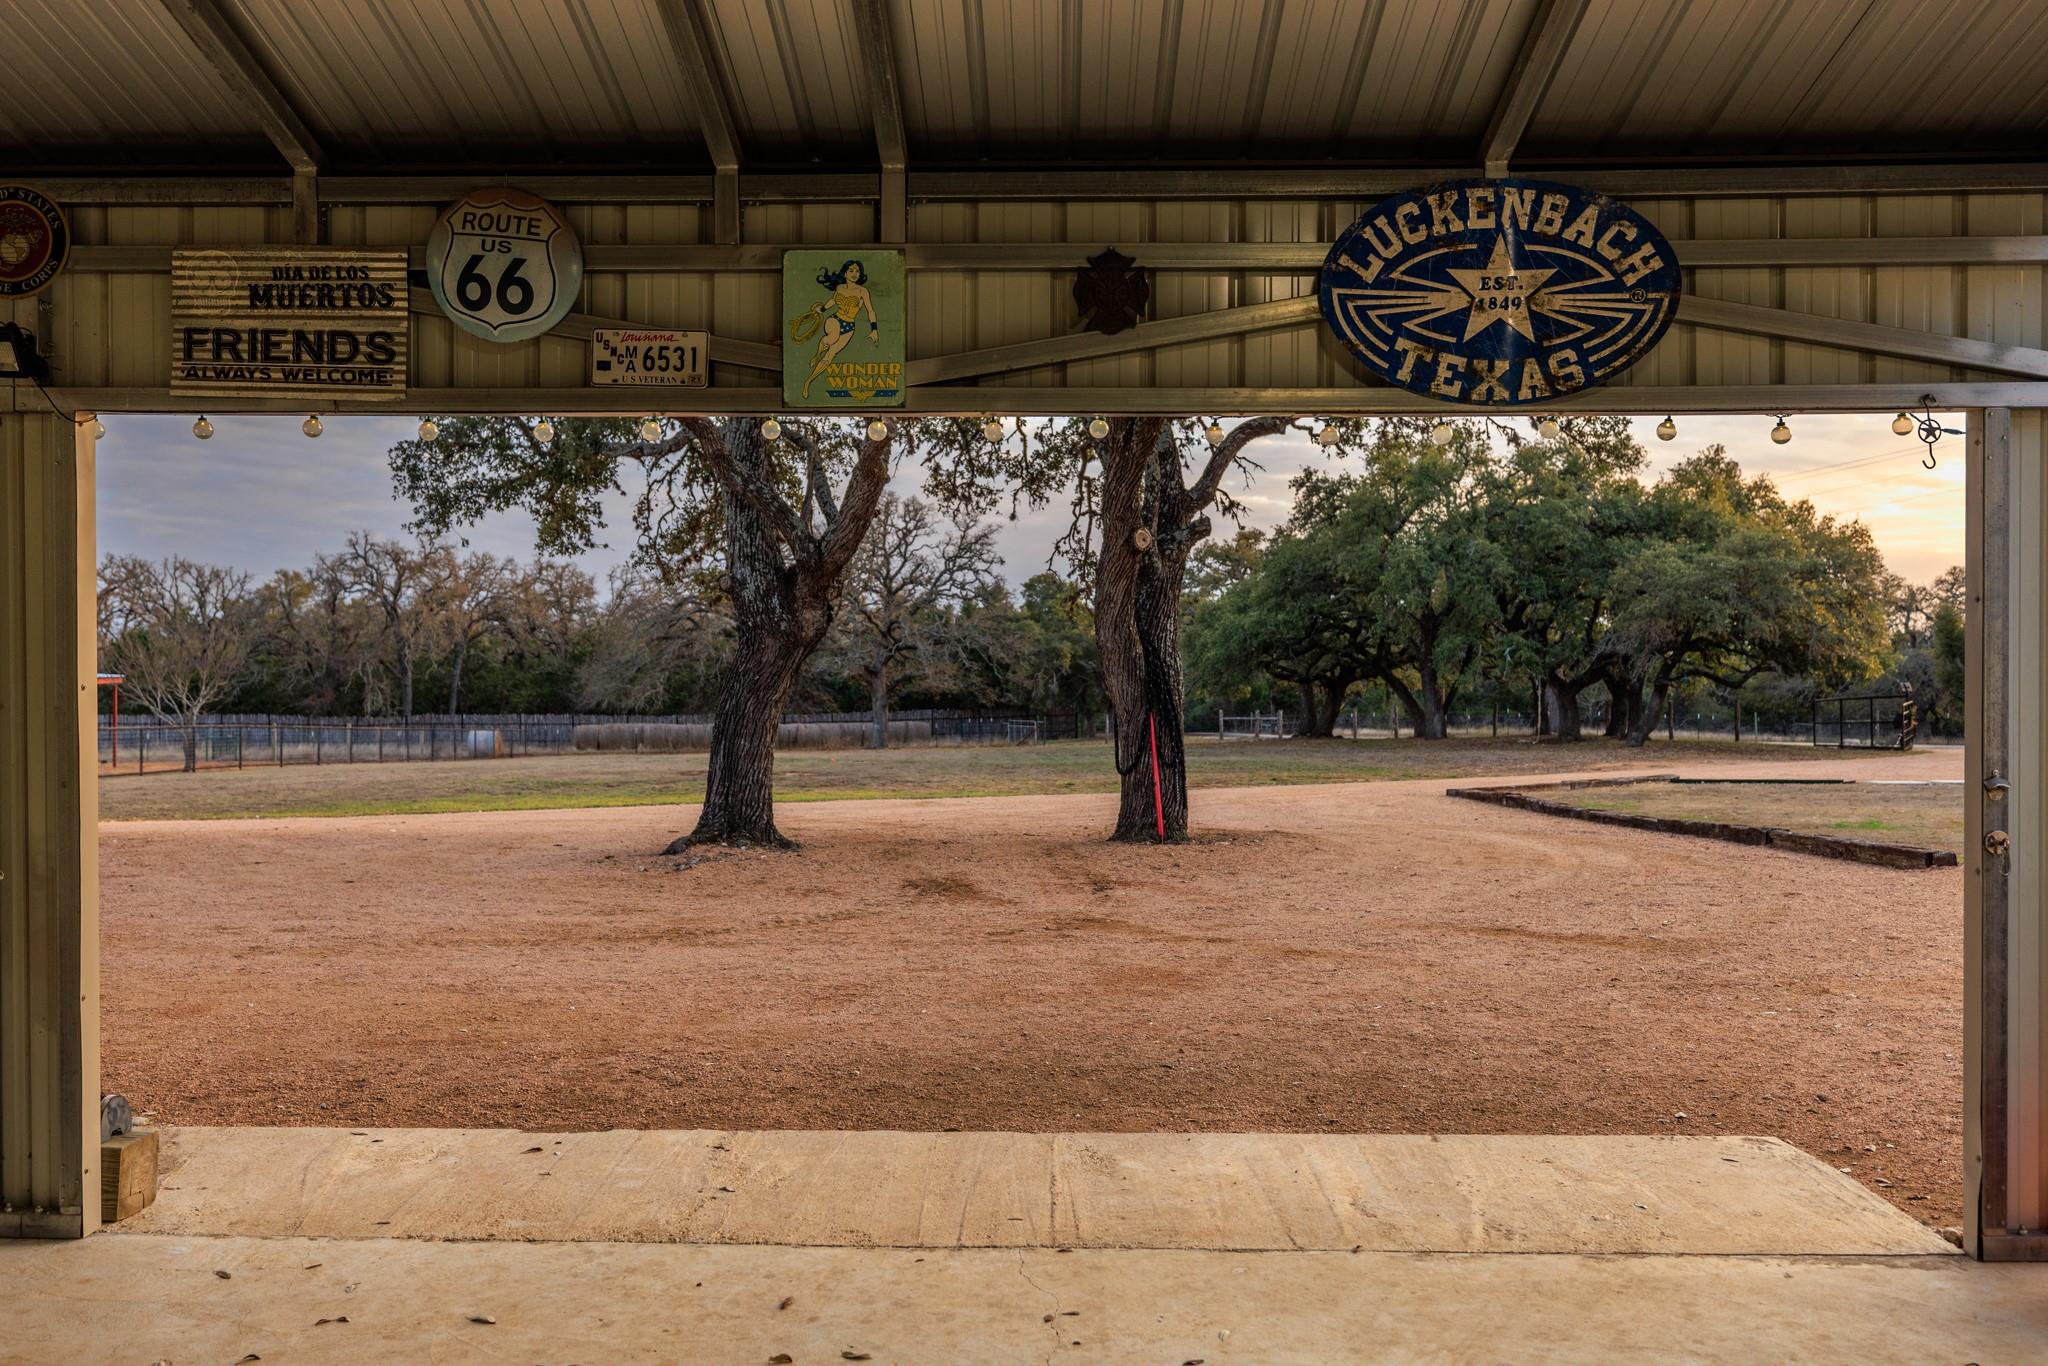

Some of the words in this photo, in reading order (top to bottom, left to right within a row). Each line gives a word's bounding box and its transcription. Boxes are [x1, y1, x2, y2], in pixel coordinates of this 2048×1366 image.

[17, 189, 61, 229] STATES
[462, 211, 542, 236] ROUTE
[481, 239, 512, 254] US
[1337, 187, 1664, 287] LUCKENBACH
[21, 258, 58, 290] CORPS
[308, 265, 332, 281] DE
[335, 265, 370, 281] LOS
[1479, 276, 1524, 291] EST.
[456, 254, 534, 315] 66
[248, 282, 395, 310] MUERTOS
[1475, 296, 1522, 311] 1849
[183, 327, 397, 365] FRIENDS
[619, 331, 680, 343] Louisiana
[643, 345, 697, 373] 6531
[826, 362, 902, 376] WONDER
[1395, 337, 1586, 401] TEXAS
[184, 365, 272, 381] ALWAYS
[281, 368, 389, 385] WELCOME
[639, 375, 677, 384] VETERAN
[826, 376, 897, 389] WOMAN
